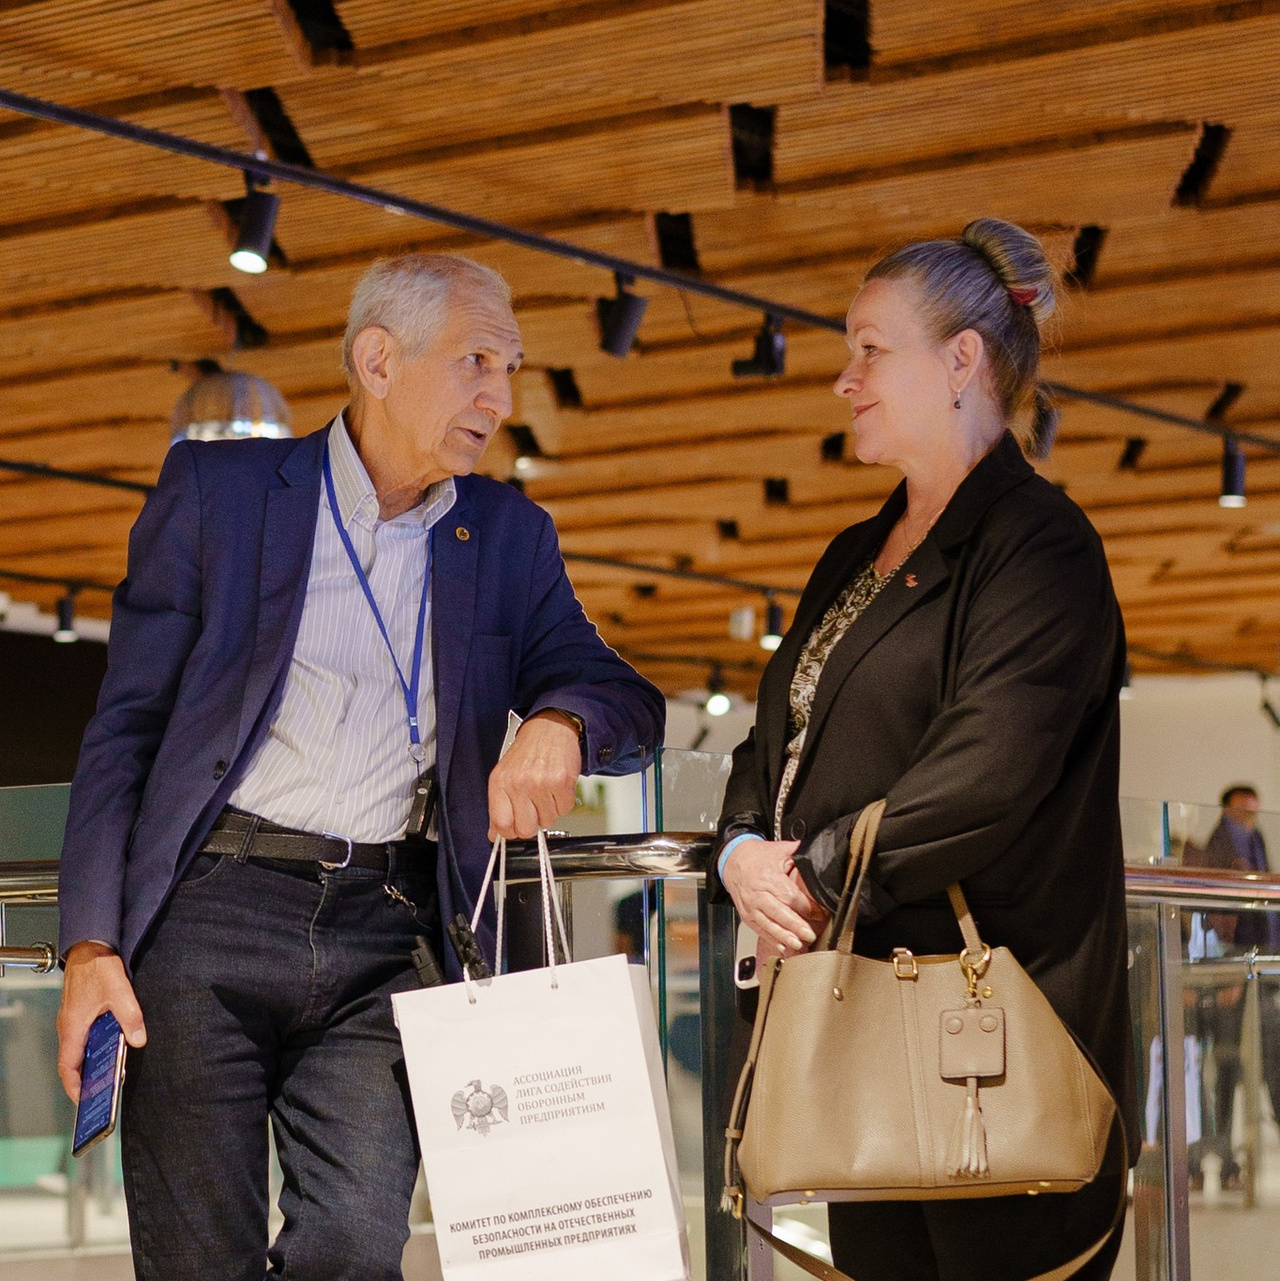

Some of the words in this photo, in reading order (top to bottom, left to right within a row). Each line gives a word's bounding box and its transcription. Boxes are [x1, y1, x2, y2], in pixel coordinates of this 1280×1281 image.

[513, 1065, 583, 1086] АССОЦИАЦИЯ
[515, 1086, 543, 1099] ЛИГА
[544, 1073, 613, 1094] СОДЕЙСТВИЯ
[517, 1092, 586, 1112] ОБОРОННЫМ
[520, 1102, 606, 1125] ПРЕДПРИЯТИЯМ
[449, 1216, 492, 1234] КОМИТЕТ
[493, 1214, 507, 1228] ПО
[508, 1201, 583, 1224] КОМПЛЕКСНОМУ
[584, 1188, 653, 1210] ОБЕСПЕЧЕНИЮ
[472, 1221, 543, 1245] БЕЗОПАСНОСТИ
[544, 1218, 558, 1233] НА
[558, 1208, 636, 1230] ОТЕЧЕСТВЕННЫХ
[478, 1236, 563, 1260] ПРОМЫШЛЕННЫХ
[563, 1223, 637, 1245] ПРЕДПРИЯТИЯХ
